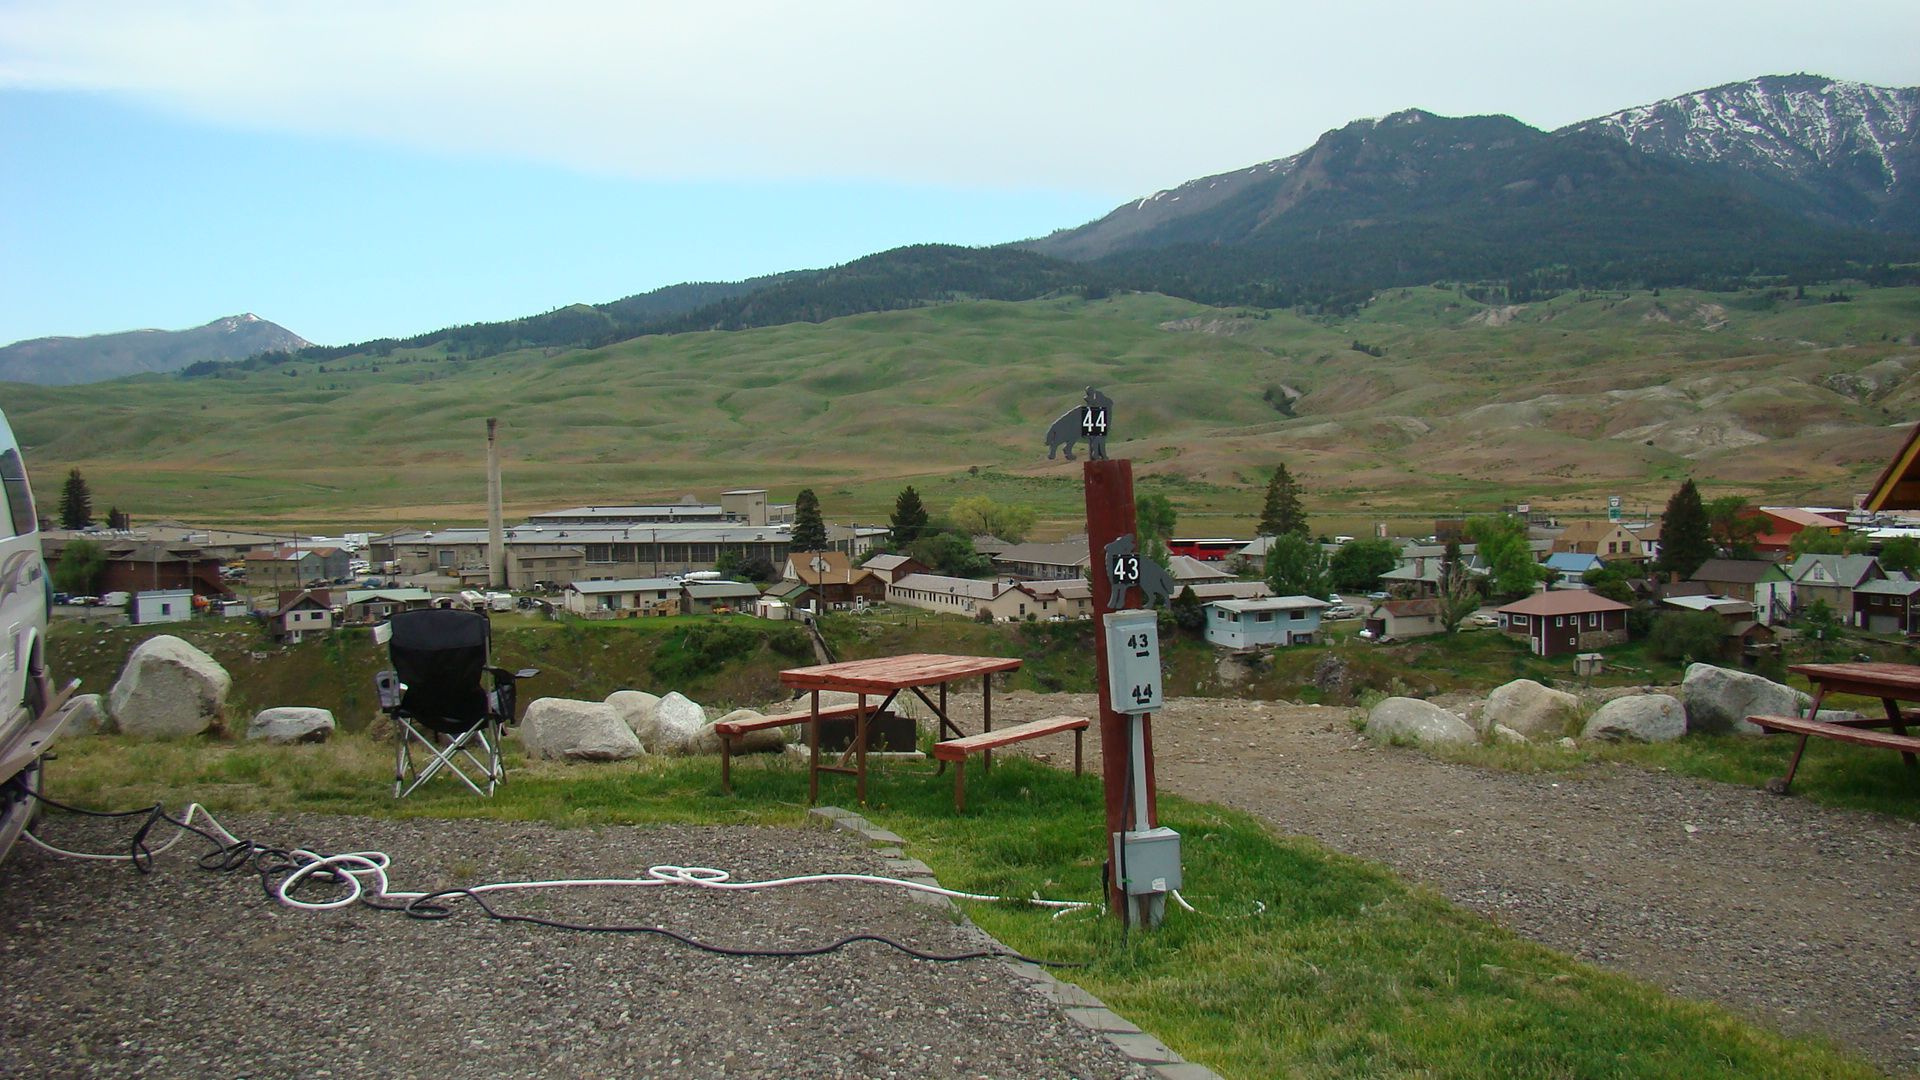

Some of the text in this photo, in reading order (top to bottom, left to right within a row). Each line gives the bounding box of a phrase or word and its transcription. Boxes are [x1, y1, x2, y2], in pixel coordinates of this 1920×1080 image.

[1082, 410, 1107, 432] 44
[1114, 558, 1139, 580] 43
[1128, 633, 1149, 649] 43
[1132, 683, 1153, 699] 44
